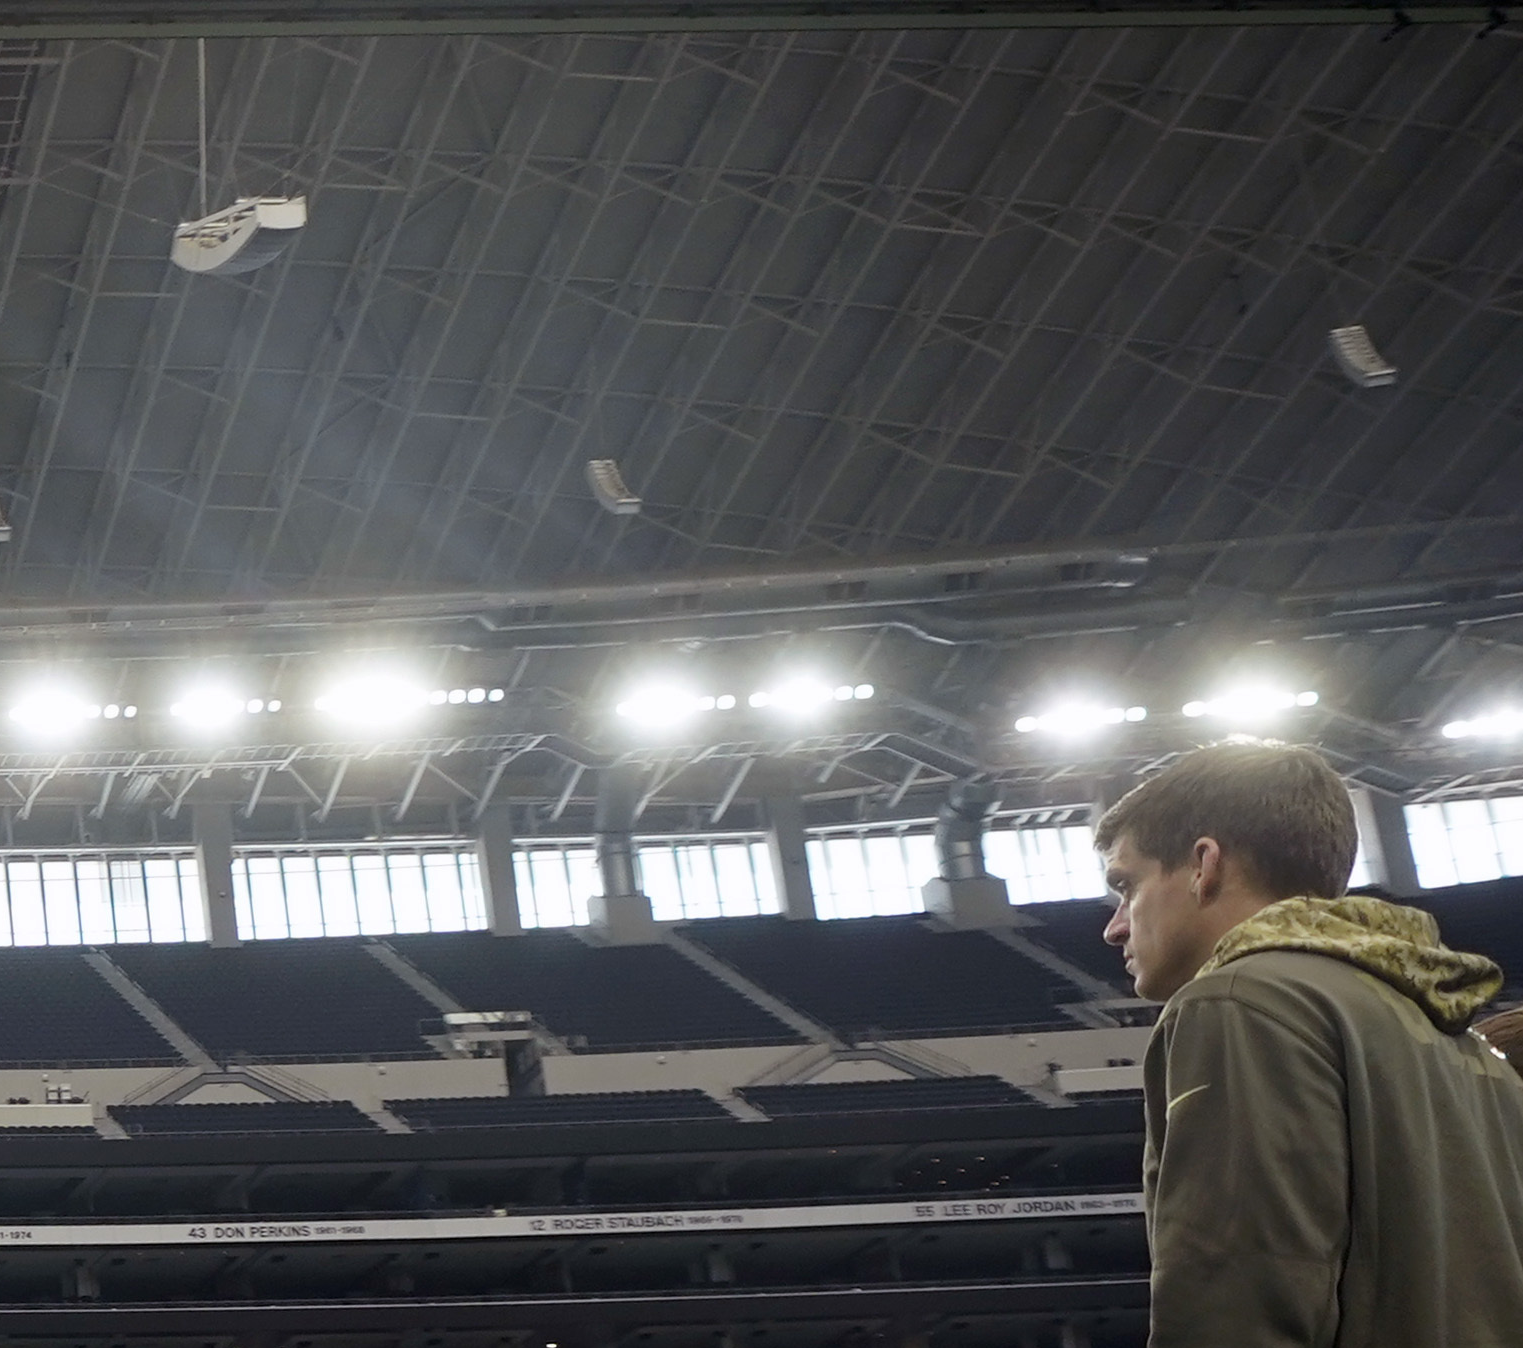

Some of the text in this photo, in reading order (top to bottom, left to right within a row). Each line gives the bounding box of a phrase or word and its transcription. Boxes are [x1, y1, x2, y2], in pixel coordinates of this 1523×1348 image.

[915, 1205, 935, 1217] 55
[943, 1204, 972, 1217] LEE
[977, 1202, 1006, 1216] ROY
[1012, 1200, 1076, 1214] JORDAN
[553, 1217, 604, 1230] ROGER
[606, 1215, 685, 1229] STAUBACH
[188, 1227, 207, 1239] 43
[214, 1226, 245, 1239] DON
[249, 1225, 311, 1238] PERKINS
